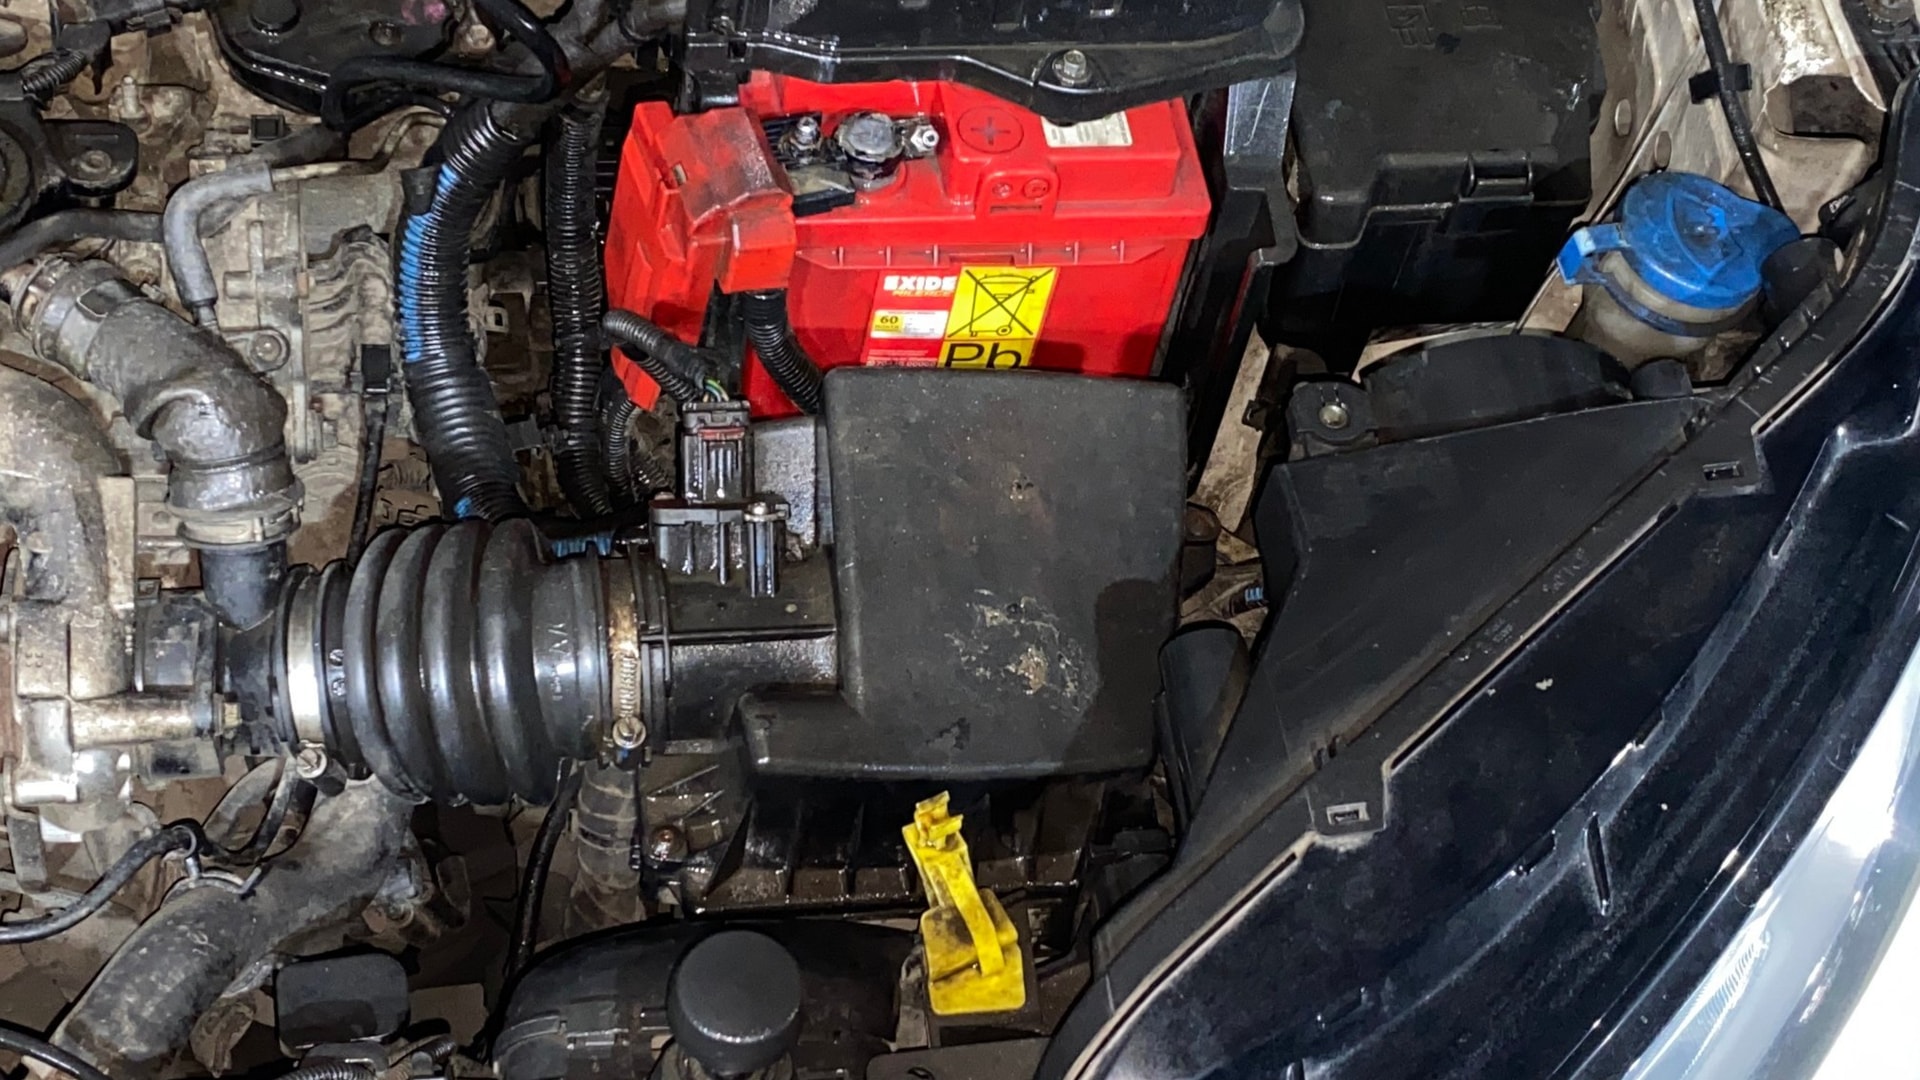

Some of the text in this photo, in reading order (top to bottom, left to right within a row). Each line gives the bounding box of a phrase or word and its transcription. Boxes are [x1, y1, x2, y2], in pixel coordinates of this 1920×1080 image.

[883, 275, 957, 291] EXIDE
[880, 316, 899, 324] 60
[944, 342, 1022, 369] Pb
